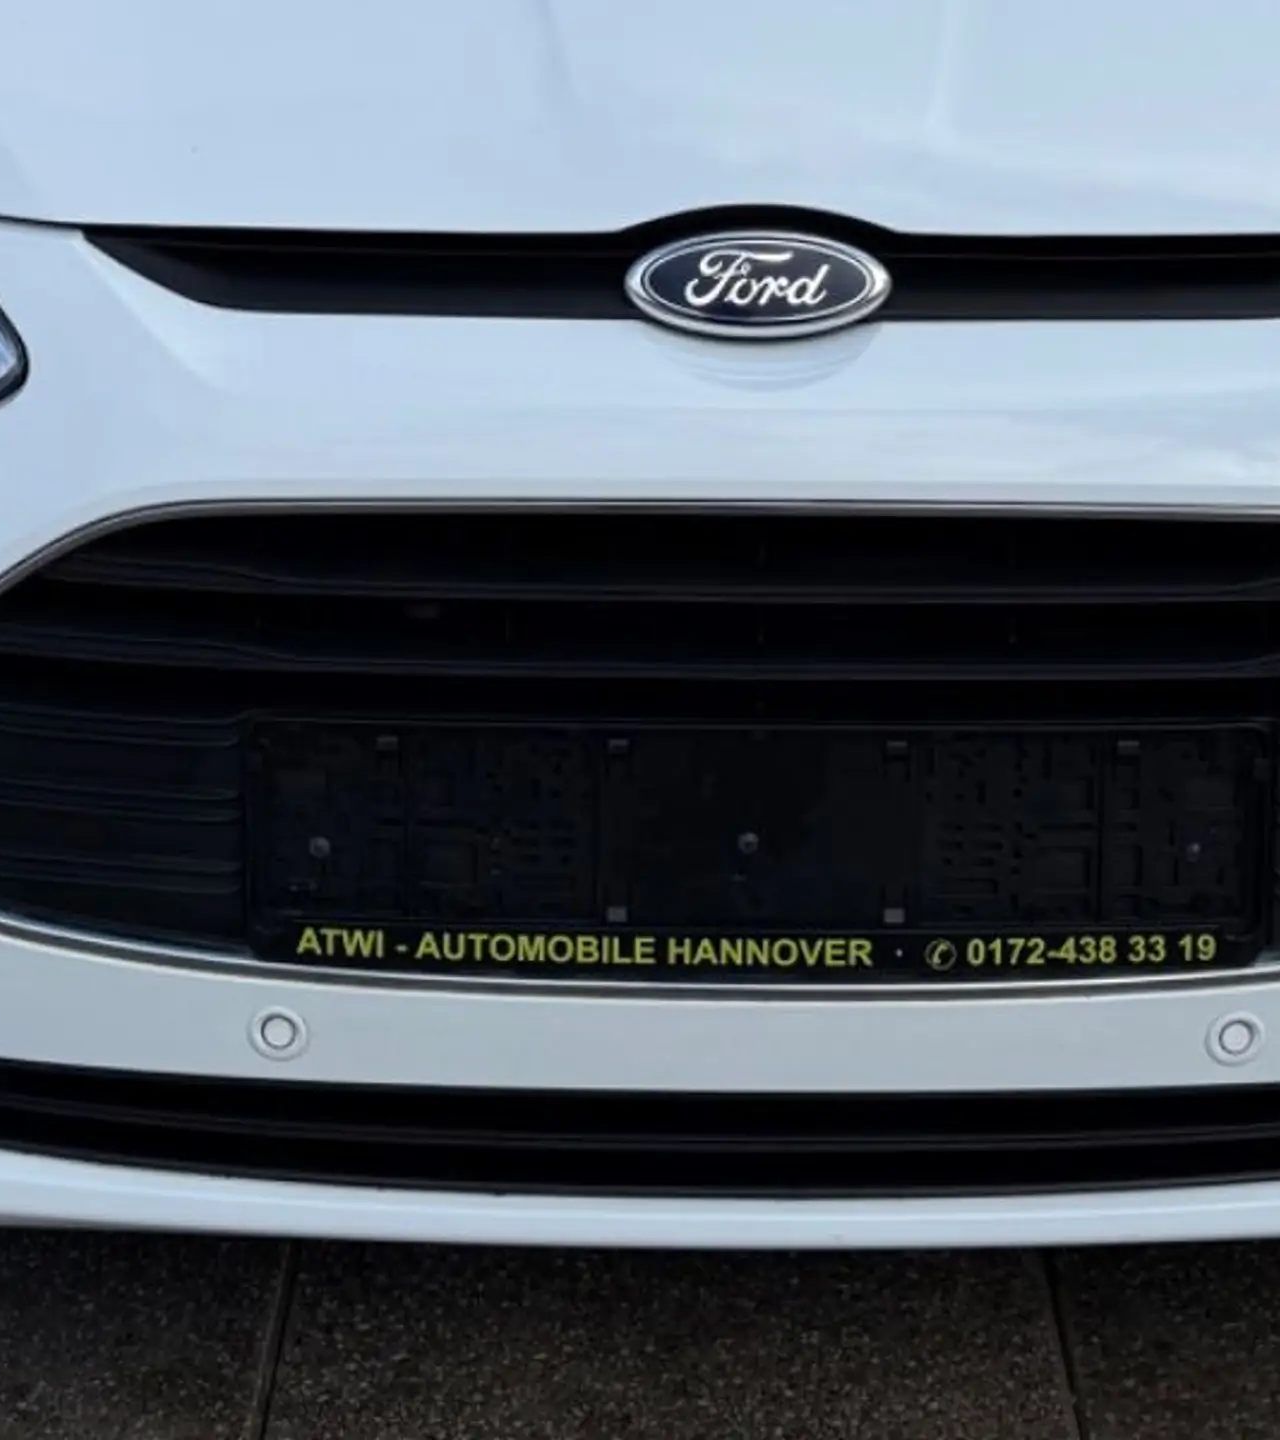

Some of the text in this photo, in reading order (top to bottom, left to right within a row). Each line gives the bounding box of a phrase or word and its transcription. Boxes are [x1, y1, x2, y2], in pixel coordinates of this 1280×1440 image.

[684, 249, 830, 306] Ford
[296, 927, 384, 956] ATWI
[414, 931, 656, 965] AUTOMOBILE
[668, 938, 873, 967] HANNOVER
[966, 936, 1118, 964] 0172-438
[1127, 936, 1166, 962] 33
[1179, 934, 1217, 961] 19
